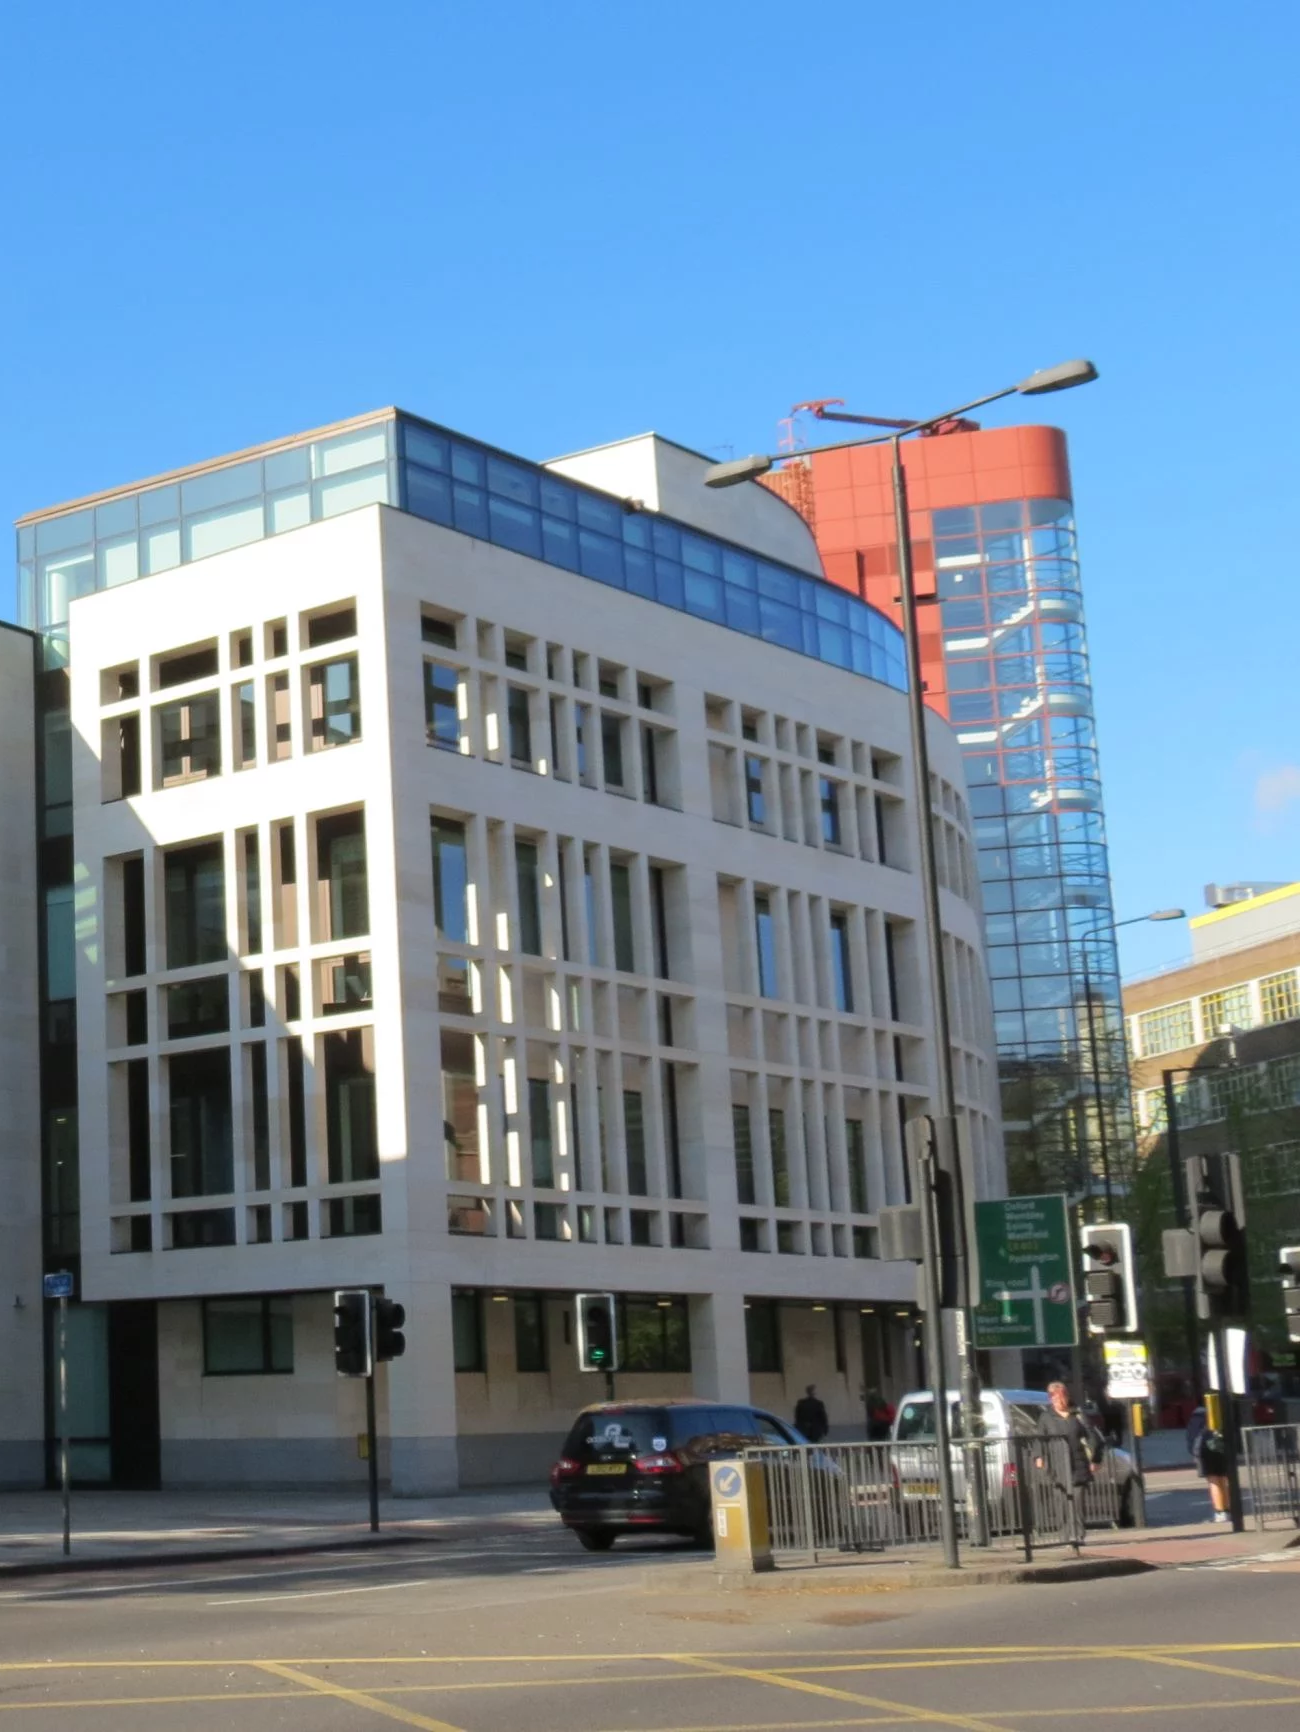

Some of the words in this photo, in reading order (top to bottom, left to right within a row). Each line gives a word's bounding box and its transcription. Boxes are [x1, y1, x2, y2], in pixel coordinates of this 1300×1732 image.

[1004, 1202, 1035, 1211] Oxford
[1005, 1211, 1045, 1221] Wembley
[1007, 1231, 1049, 1240] Westfield
[1009, 1253, 1060, 1264] Paddington
